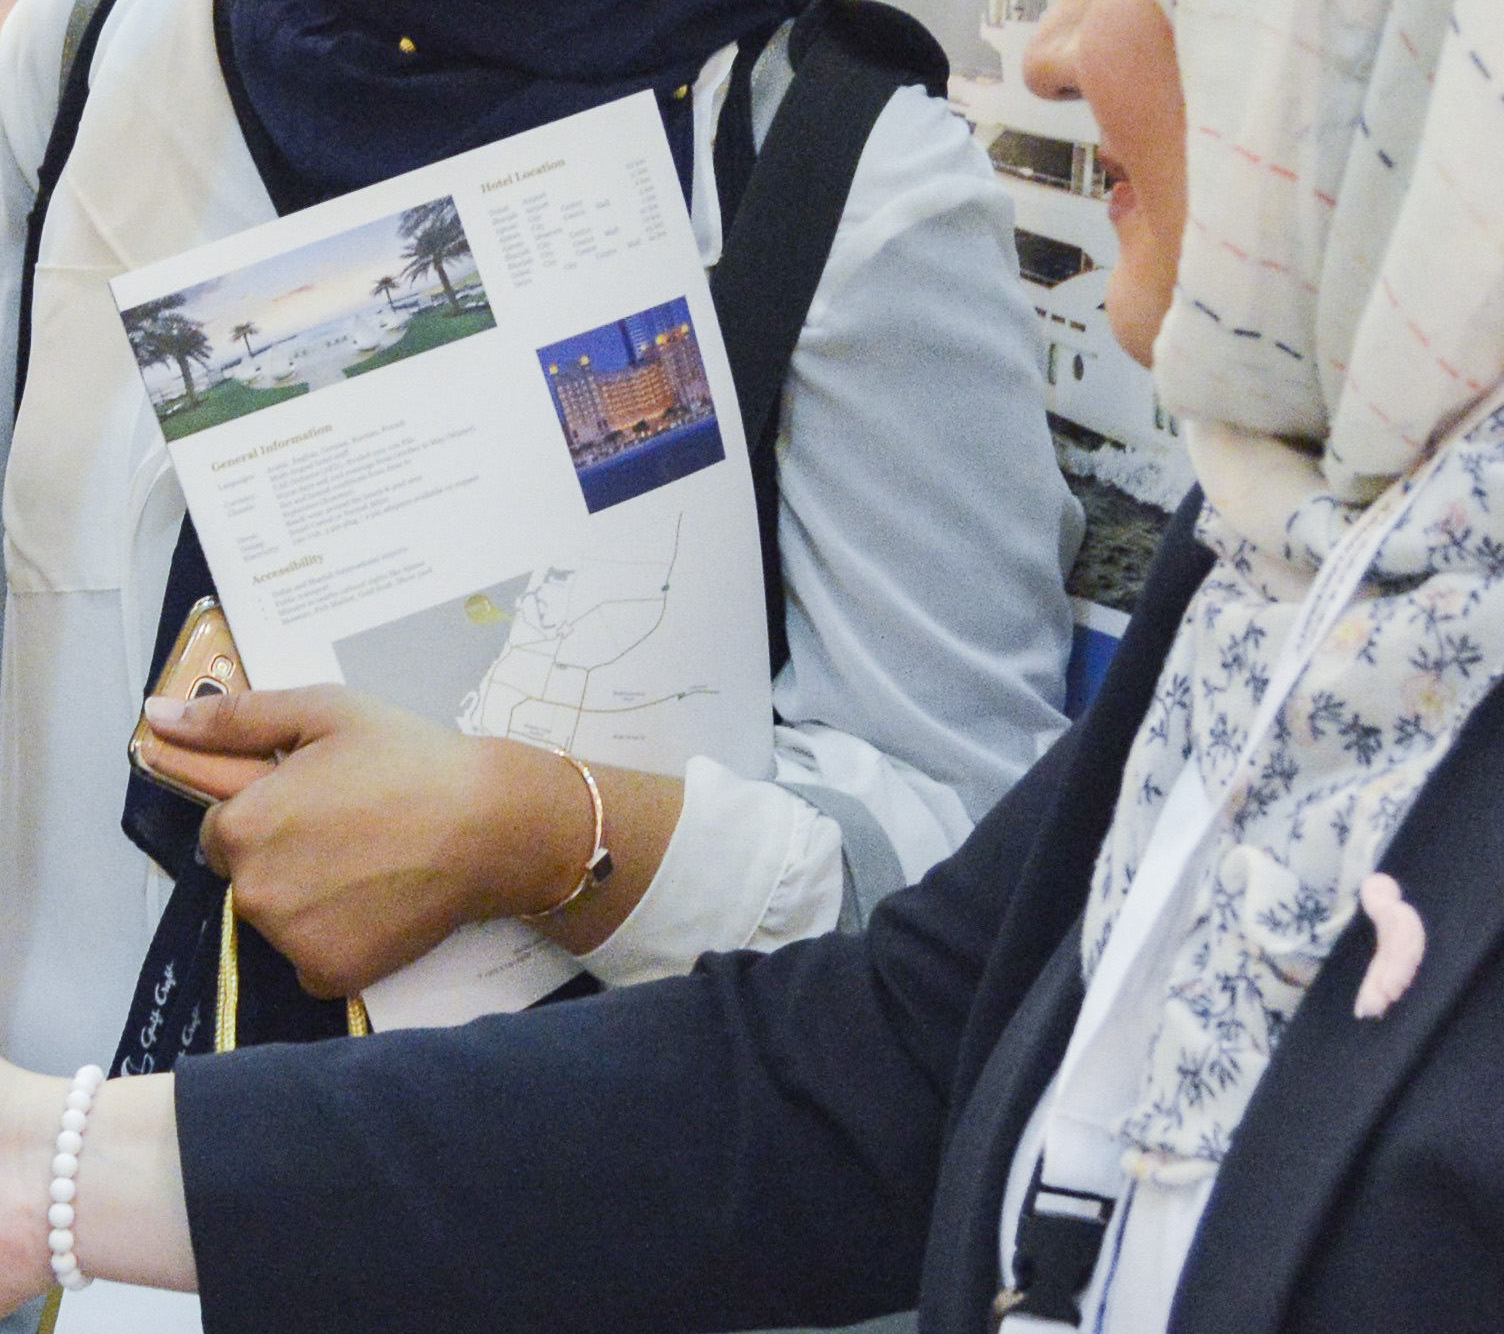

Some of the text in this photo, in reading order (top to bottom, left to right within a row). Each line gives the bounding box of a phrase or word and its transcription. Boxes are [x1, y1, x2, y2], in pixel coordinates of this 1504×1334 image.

[481, 158, 566, 194] Hotel Location
[211, 447, 258, 473] General
[260, 423, 333, 456] Information
[252, 553, 324, 586] Accessibility
